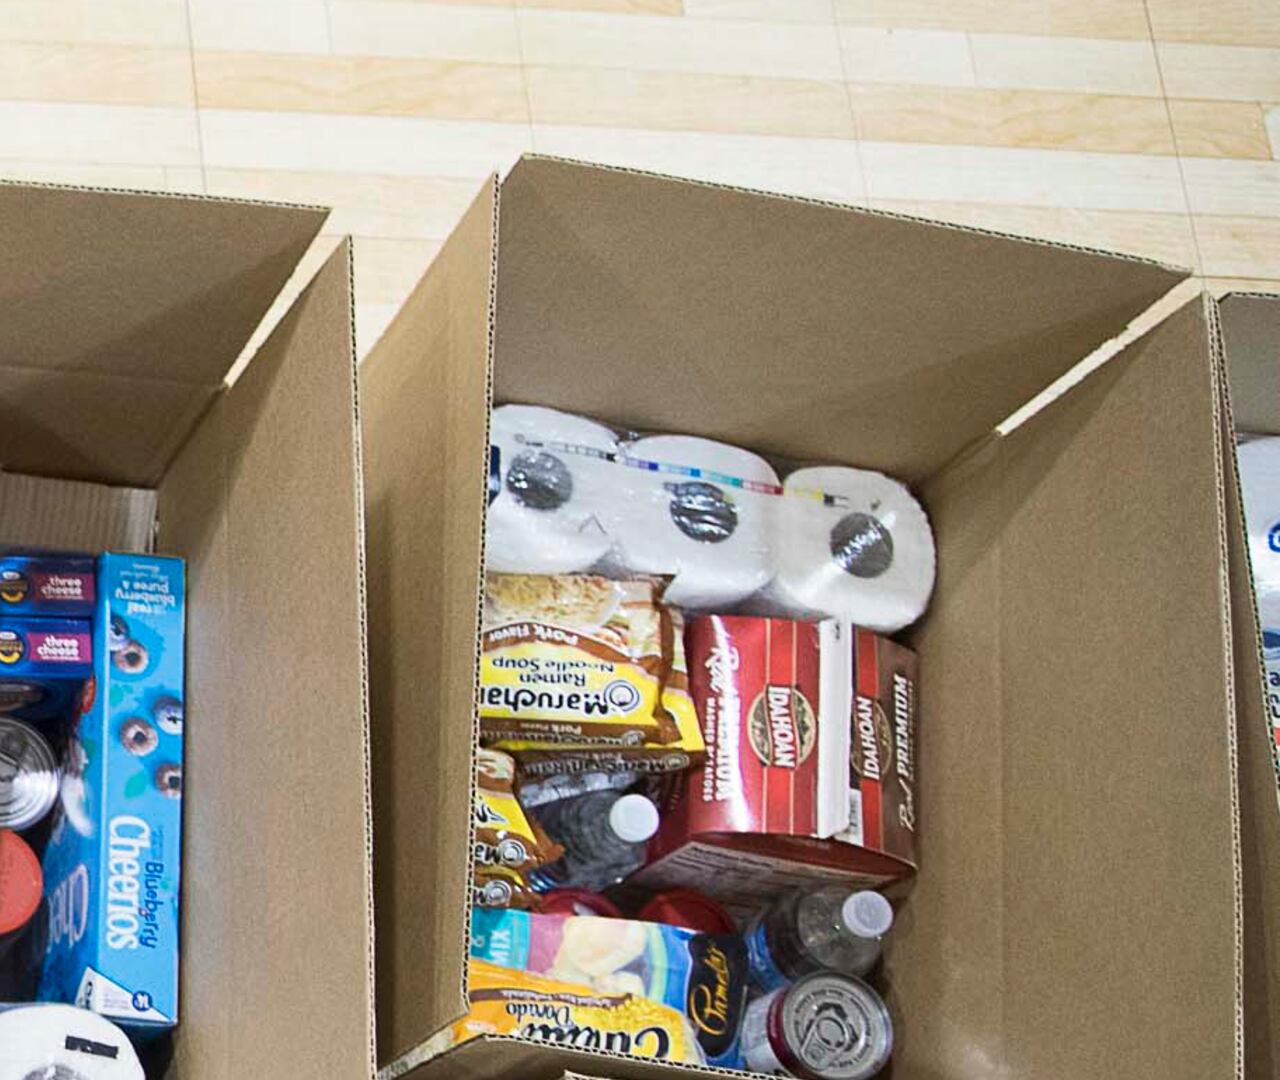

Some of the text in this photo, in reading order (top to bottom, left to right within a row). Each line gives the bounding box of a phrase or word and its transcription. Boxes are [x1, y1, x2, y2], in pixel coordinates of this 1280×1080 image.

[41, 585, 83, 596] cheese
[49, 576, 82, 586] three
[45, 635, 79, 647] three
[490, 624, 579, 646] Pork Flavor
[37, 645, 80, 657] cheese
[492, 657, 615, 674] Noodle Soup
[520, 673, 586, 687] Ramen
[768, 685, 797, 768] IDAHOAN
[856, 695, 881, 781] IDAHOAN
[893, 673, 915, 834] Real PREMIUM
[107, 814, 151, 950] Cheerios
[140, 861, 165, 949] Blueberry
[490, 928, 511, 963] MIX
[505, 1002, 571, 1029] Dorado
